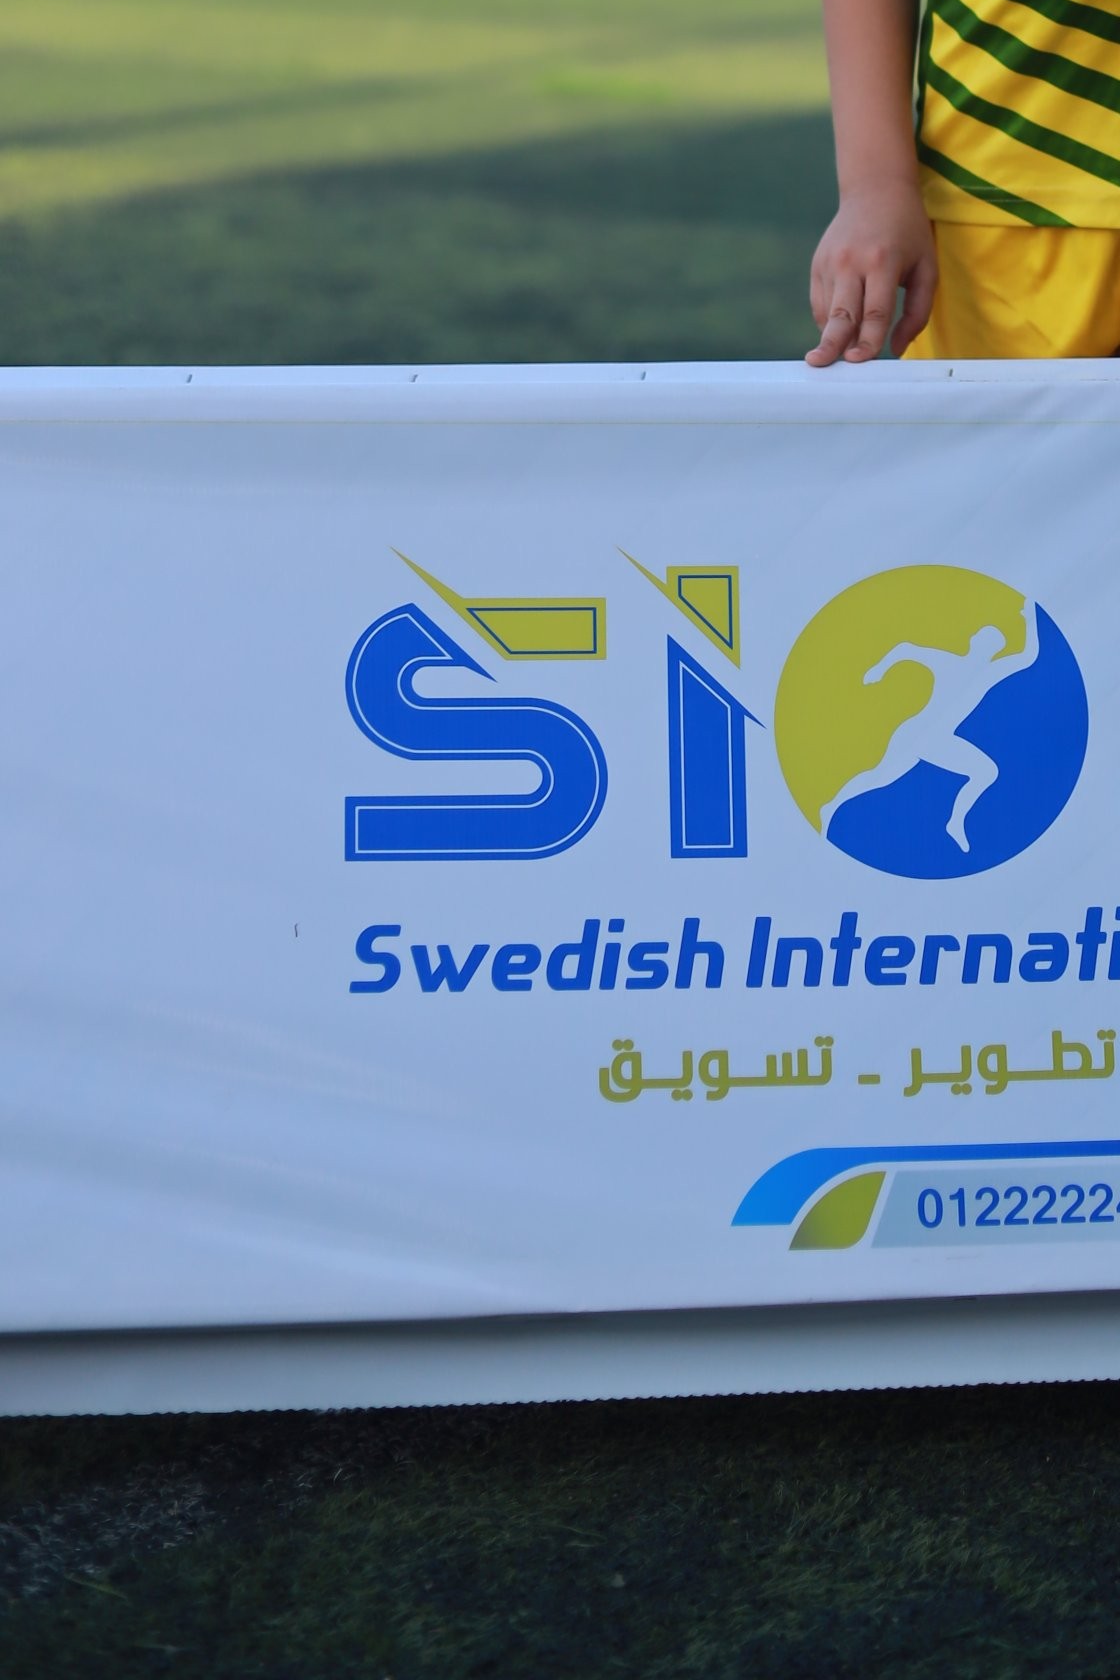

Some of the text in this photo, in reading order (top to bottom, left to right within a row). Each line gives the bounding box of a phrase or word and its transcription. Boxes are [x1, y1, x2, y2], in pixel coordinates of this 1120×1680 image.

[348, 916, 726, 994] Swedish
[598, 1036, 834, 1103] تسويق
[903, 1029, 1116, 1097] تطوير
